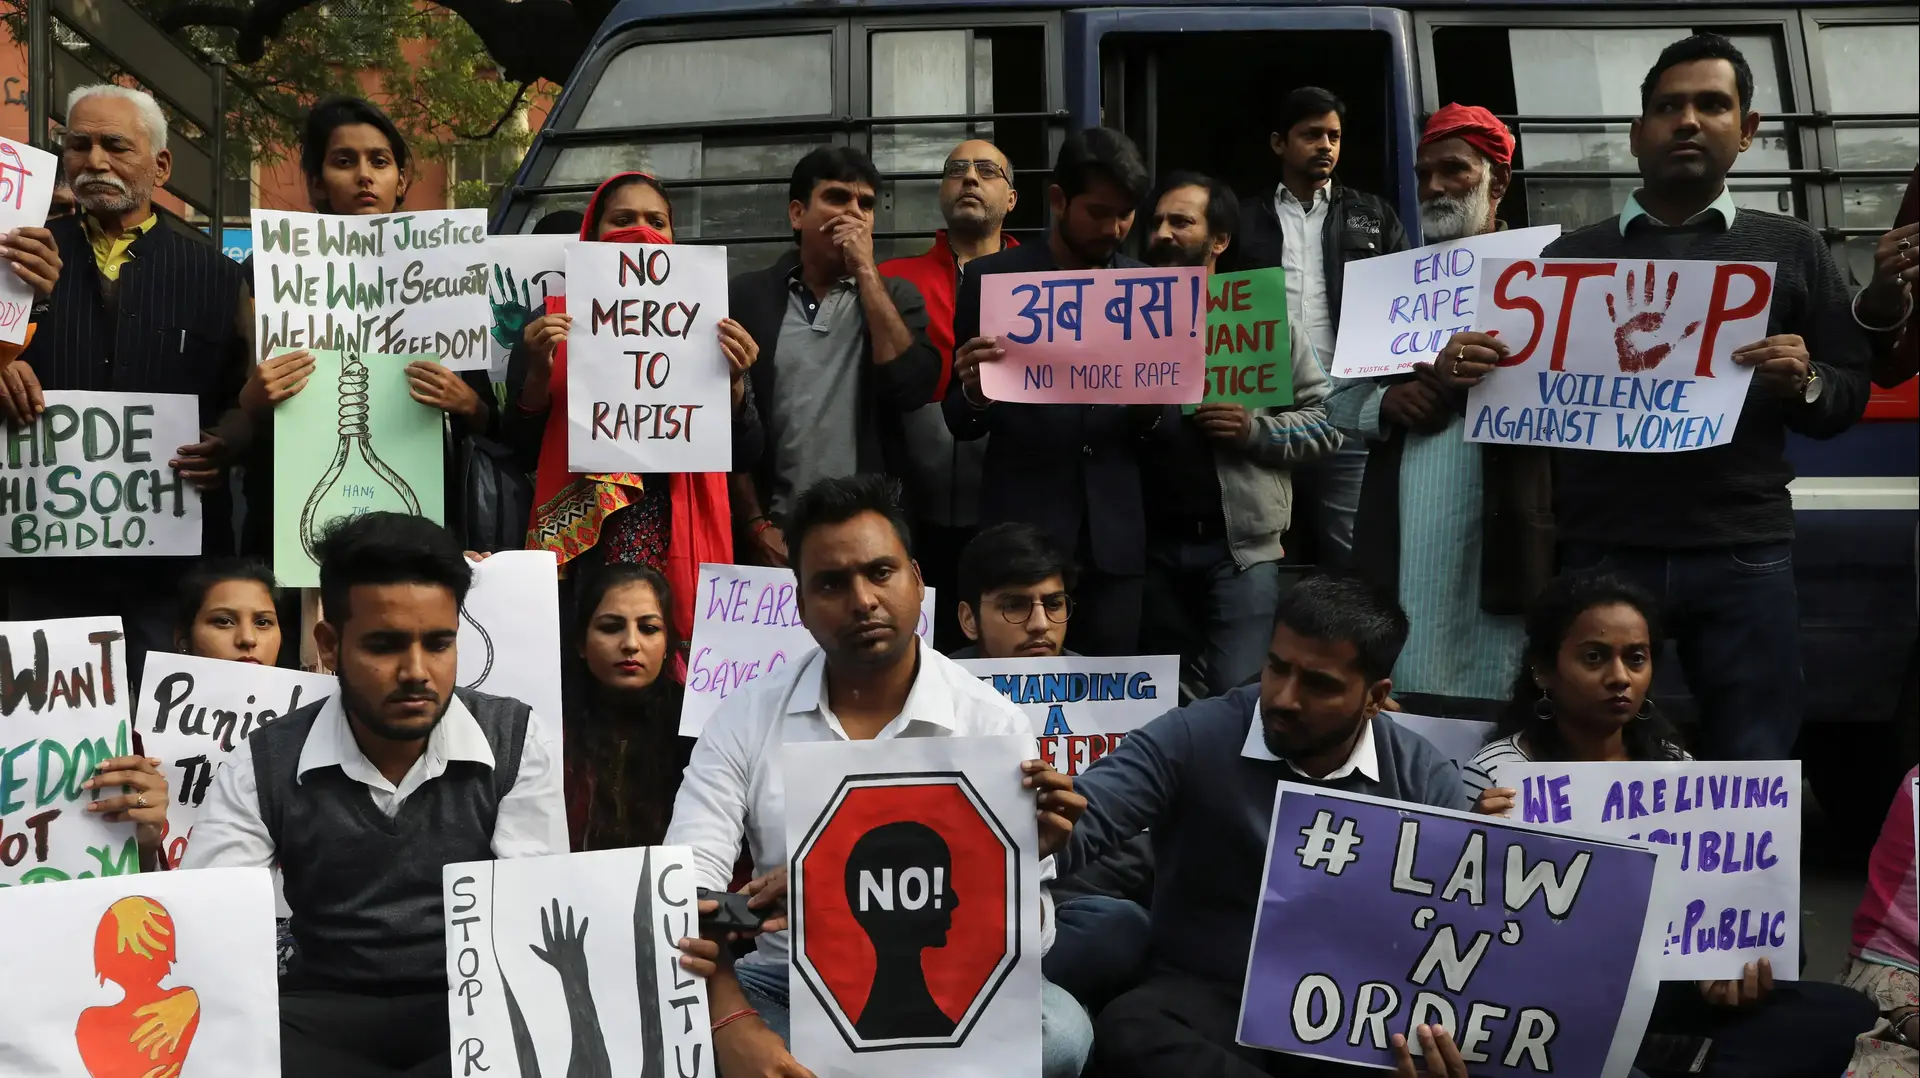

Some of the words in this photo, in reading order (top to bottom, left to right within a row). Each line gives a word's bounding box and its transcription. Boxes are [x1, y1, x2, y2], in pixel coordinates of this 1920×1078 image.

[261, 218, 310, 256] WE
[317, 216, 390, 257] WANT
[272, 263, 320, 304] WE
[326, 262, 398, 312] WANT
[400, 261, 488, 305] SECURITY
[619, 248, 670, 287] NO
[1414, 248, 1474, 284] END
[1006, 277, 1094, 344] अब
[1206, 280, 1252, 313] WE
[1388, 286, 1474, 324] RAPE
[261, 310, 305, 361] WE
[308, 313, 380, 352] WANT
[375, 309, 487, 361] FREEDOM
[592, 298, 701, 340] MERCY
[1390, 325, 1471, 355] CULT
[623, 350, 670, 390] TO
[1025, 364, 1052, 390] NO
[1070, 364, 1123, 389] MORE
[1135, 362, 1180, 387] RAPE
[1358, 365, 1389, 373] JUSTICE
[1538, 371, 1696, 413] VOILENCE
[592, 401, 703, 443] RAPIST
[1471, 405, 1602, 445] AGAINST
[1616, 413, 1724, 450] WOMEN
[44, 465, 187, 519] SOCH
[343, 485, 375, 499] HANG
[706, 577, 750, 622] WE
[0, 629, 124, 717] WANT
[690, 647, 760, 699] SAVE
[977, 672, 1157, 704] MANDING
[1043, 704, 1074, 736] A
[0, 719, 128, 816] EDOM
[1522, 774, 1572, 824] WE
[1601, 778, 1666, 823] ARE
[1674, 775, 1789, 813] LIVING
[0, 809, 62, 867] OT
[859, 866, 944, 912] NO!
[1390, 818, 1594, 921] LAW
[451, 876, 483, 1016] STOP
[1290, 972, 1560, 1073] ORDER
